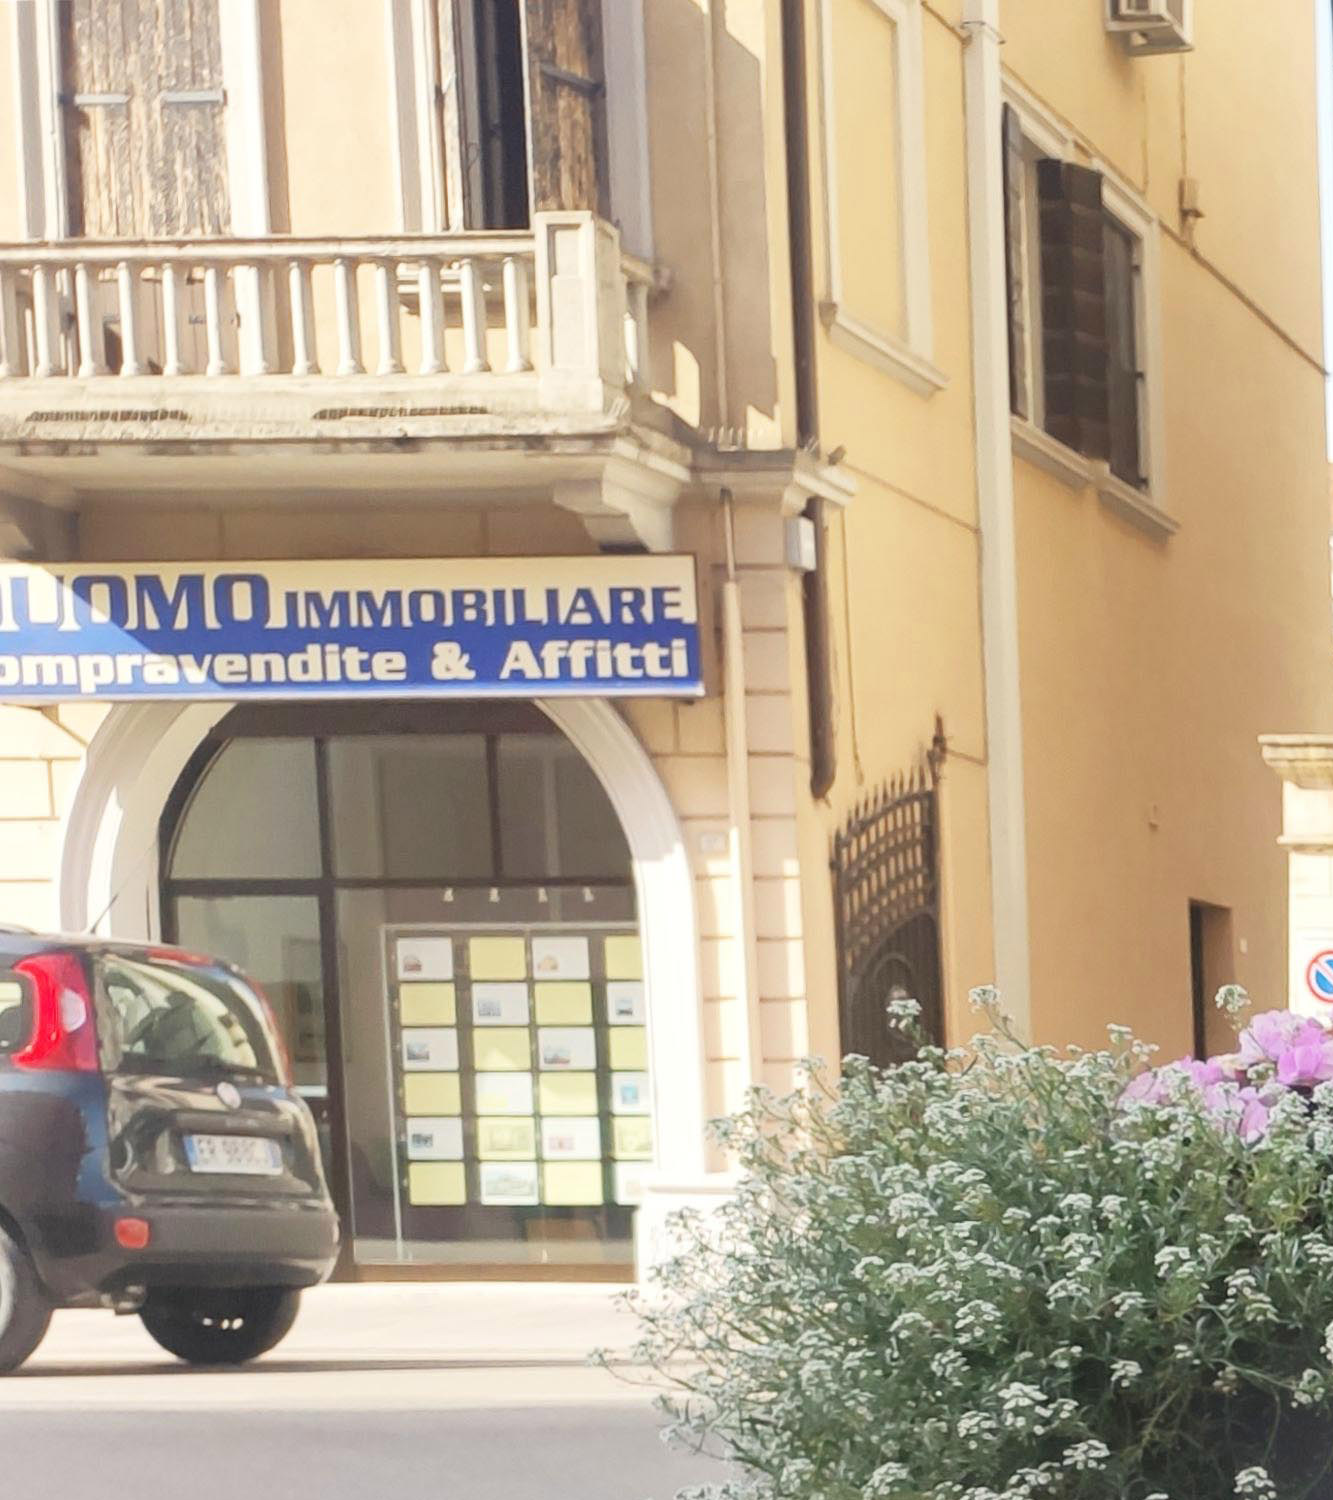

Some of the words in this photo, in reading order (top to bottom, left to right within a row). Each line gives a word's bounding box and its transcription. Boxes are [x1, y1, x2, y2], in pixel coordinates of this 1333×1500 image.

[0, 573, 270, 631] UOMO
[286, 586, 684, 628] IMMOBILIARE
[431, 640, 476, 681] &
[499, 638, 688, 680] Affitti
